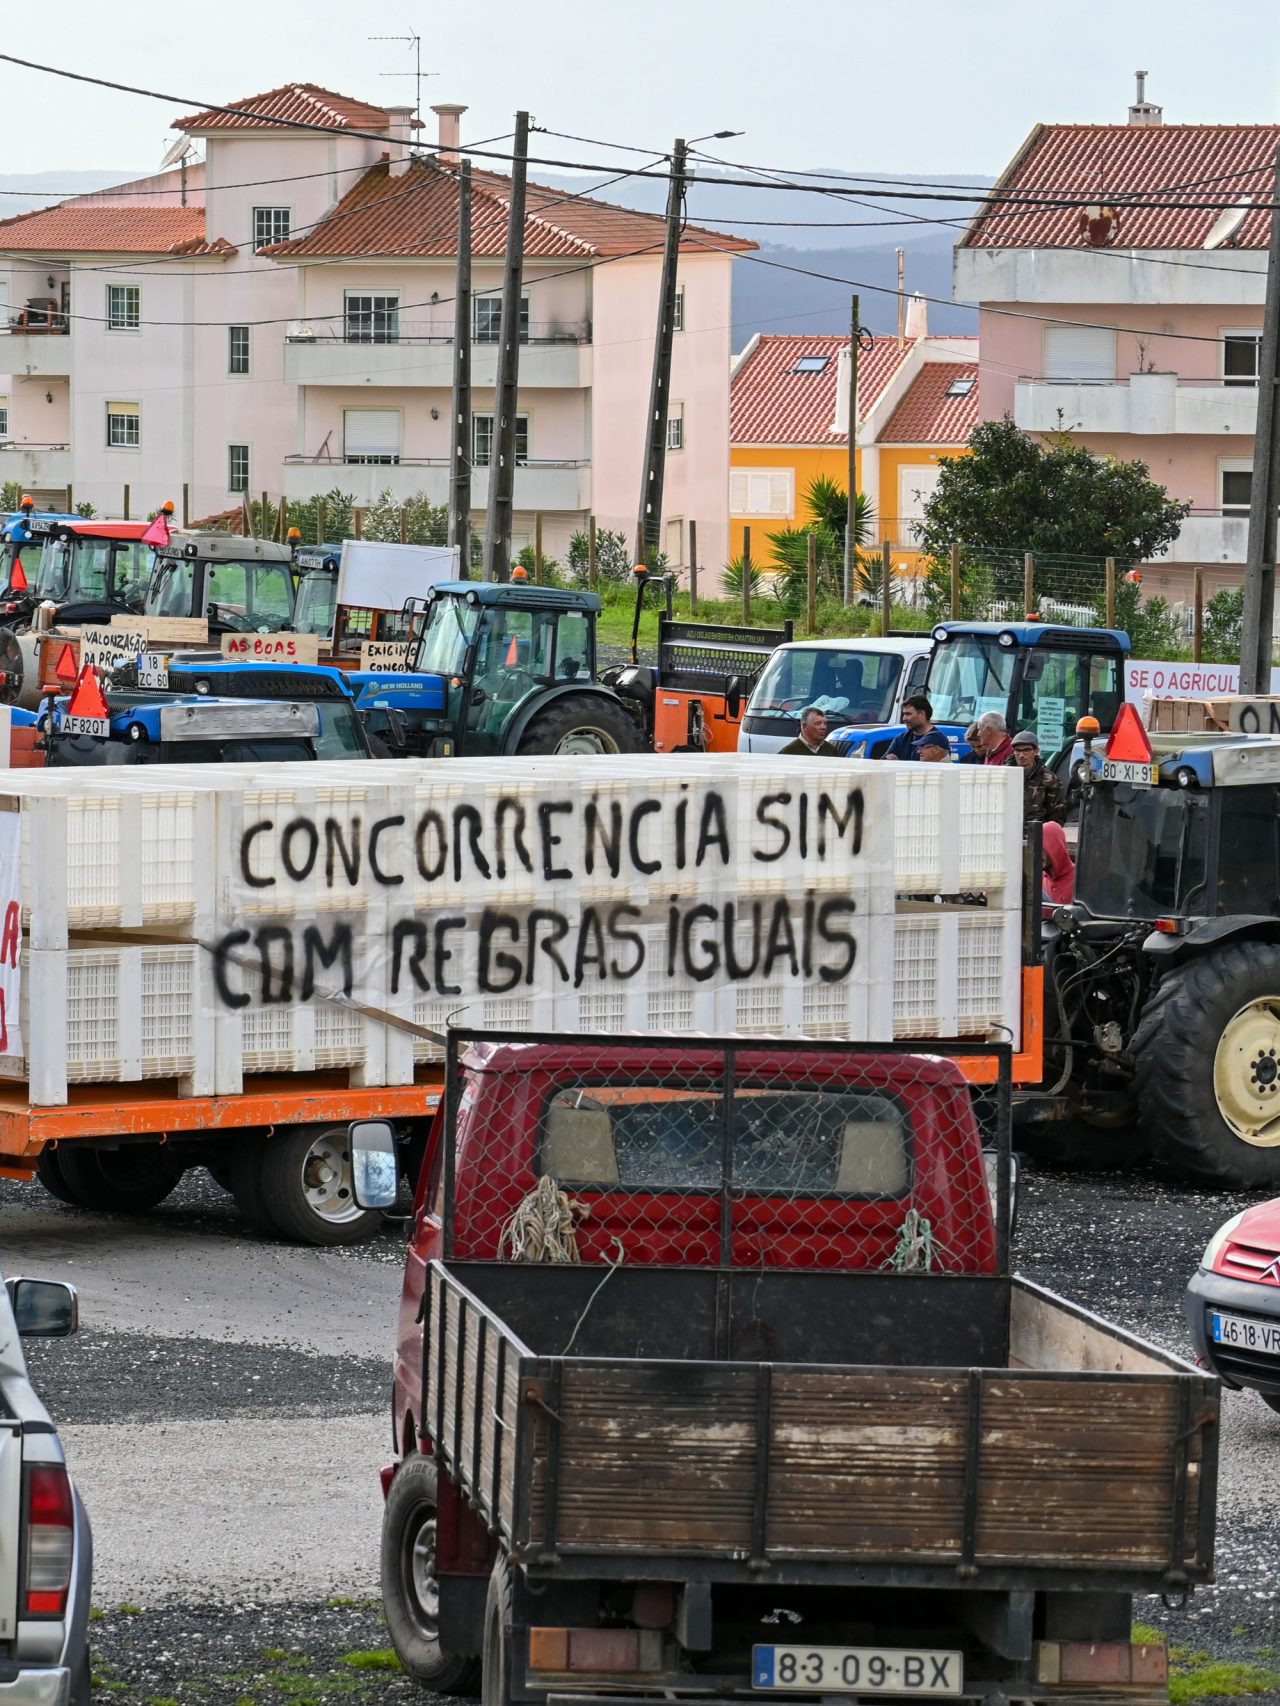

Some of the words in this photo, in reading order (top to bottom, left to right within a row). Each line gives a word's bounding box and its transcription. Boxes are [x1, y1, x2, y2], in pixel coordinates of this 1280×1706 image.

[228, 638, 250, 653] AS
[254, 638, 296, 655] BOAS
[148, 656, 158, 669] 18
[1129, 669, 1149, 688] SE
[1153, 671, 1165, 689] O
[1168, 672, 1240, 693] AGRICUL
[753, 787, 864, 862] SIM
[213, 920, 354, 1010] COM
[390, 904, 645, 996] REGRAS
